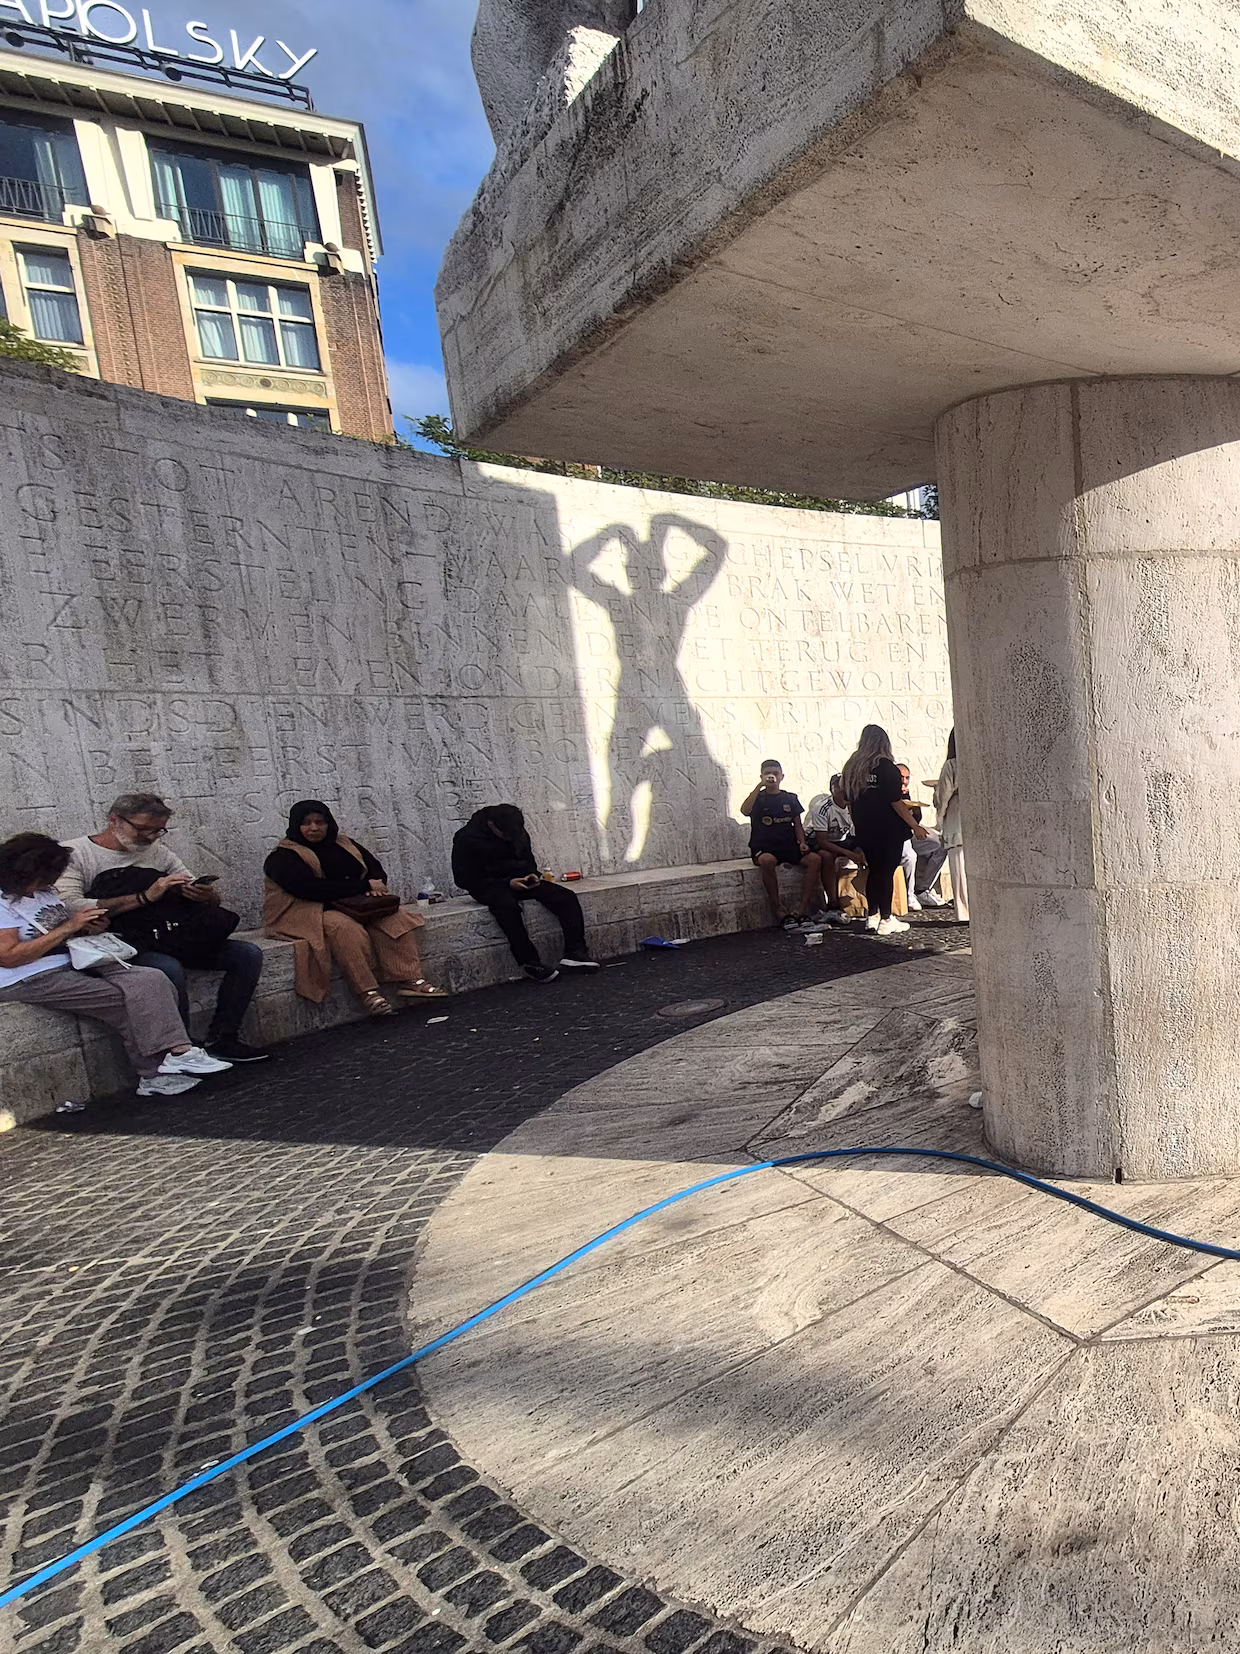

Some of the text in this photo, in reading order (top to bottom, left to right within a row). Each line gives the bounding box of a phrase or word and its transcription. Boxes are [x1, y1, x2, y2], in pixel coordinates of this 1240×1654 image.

[16, 483, 400, 566] GESTERNTEN
[446, 538, 571, 586] MAAR
[590, 561, 707, 597] GEEST
[726, 573, 812, 602] BRAK
[829, 580, 896, 606] WET
[99, 445, 236, 503] TOT
[276, 479, 452, 533] AREND
[481, 511, 572, 553] WAS
[701, 539, 869, 575] SCHEPSEL
[84, 543, 424, 611] EERSTELING
[452, 586, 655, 627] DAALDEN
[674, 603, 721, 628] DE
[740, 607, 948, 636] ONTELBAREN
[39, 590, 925, 663] ZWERMEN BINNEN DE WET TERUG EN
[102, 648, 225, 686] HET
[264, 655, 425, 691] LEVEN
[457, 660, 622, 693] ONDER
[637, 667, 946, 693] NACHTGEWOLKT
[356, 701, 489, 731] WERD
[512, 702, 618, 729] GEEN
[636, 701, 736, 727] MENS
[755, 701, 824, 728] VRIJ
[841, 700, 909, 722] DAN
[88, 743, 371, 786] BEHEERST
[402, 738, 497, 771] VAN
